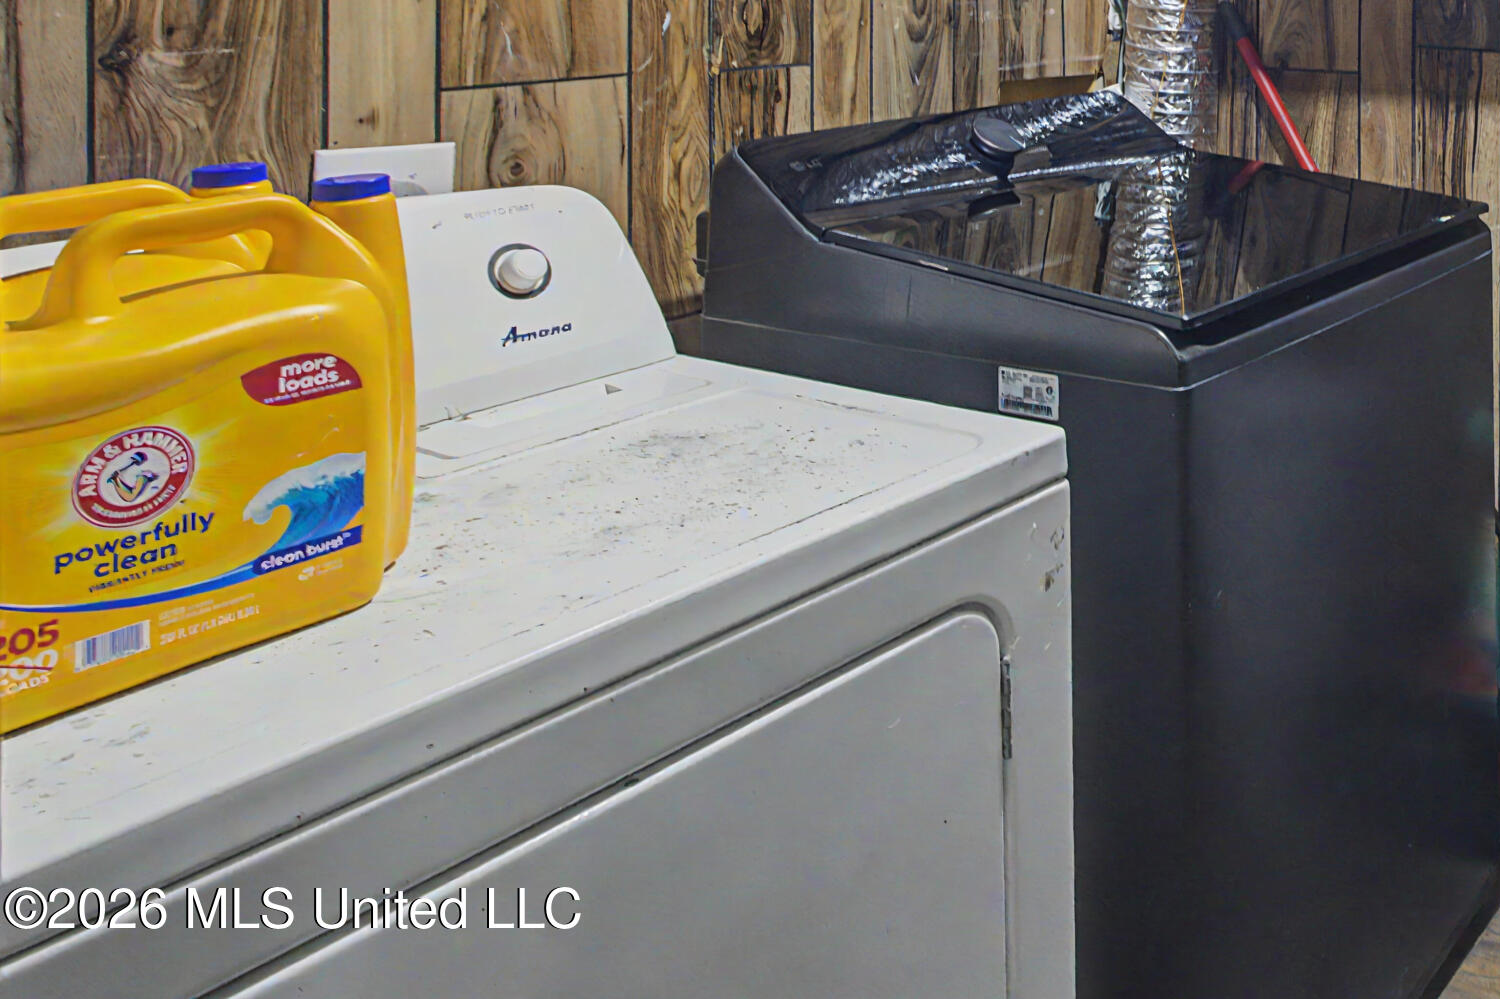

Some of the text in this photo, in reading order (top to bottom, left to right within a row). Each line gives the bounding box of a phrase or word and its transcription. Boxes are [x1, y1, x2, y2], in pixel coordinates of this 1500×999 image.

[501, 322, 572, 347] Amana
[278, 368, 340, 394] loads
[280, 355, 338, 378] more
[78, 432, 189, 498] ARM & HAMMER
[53, 511, 216, 575] powerfully
[94, 543, 179, 578] clean
